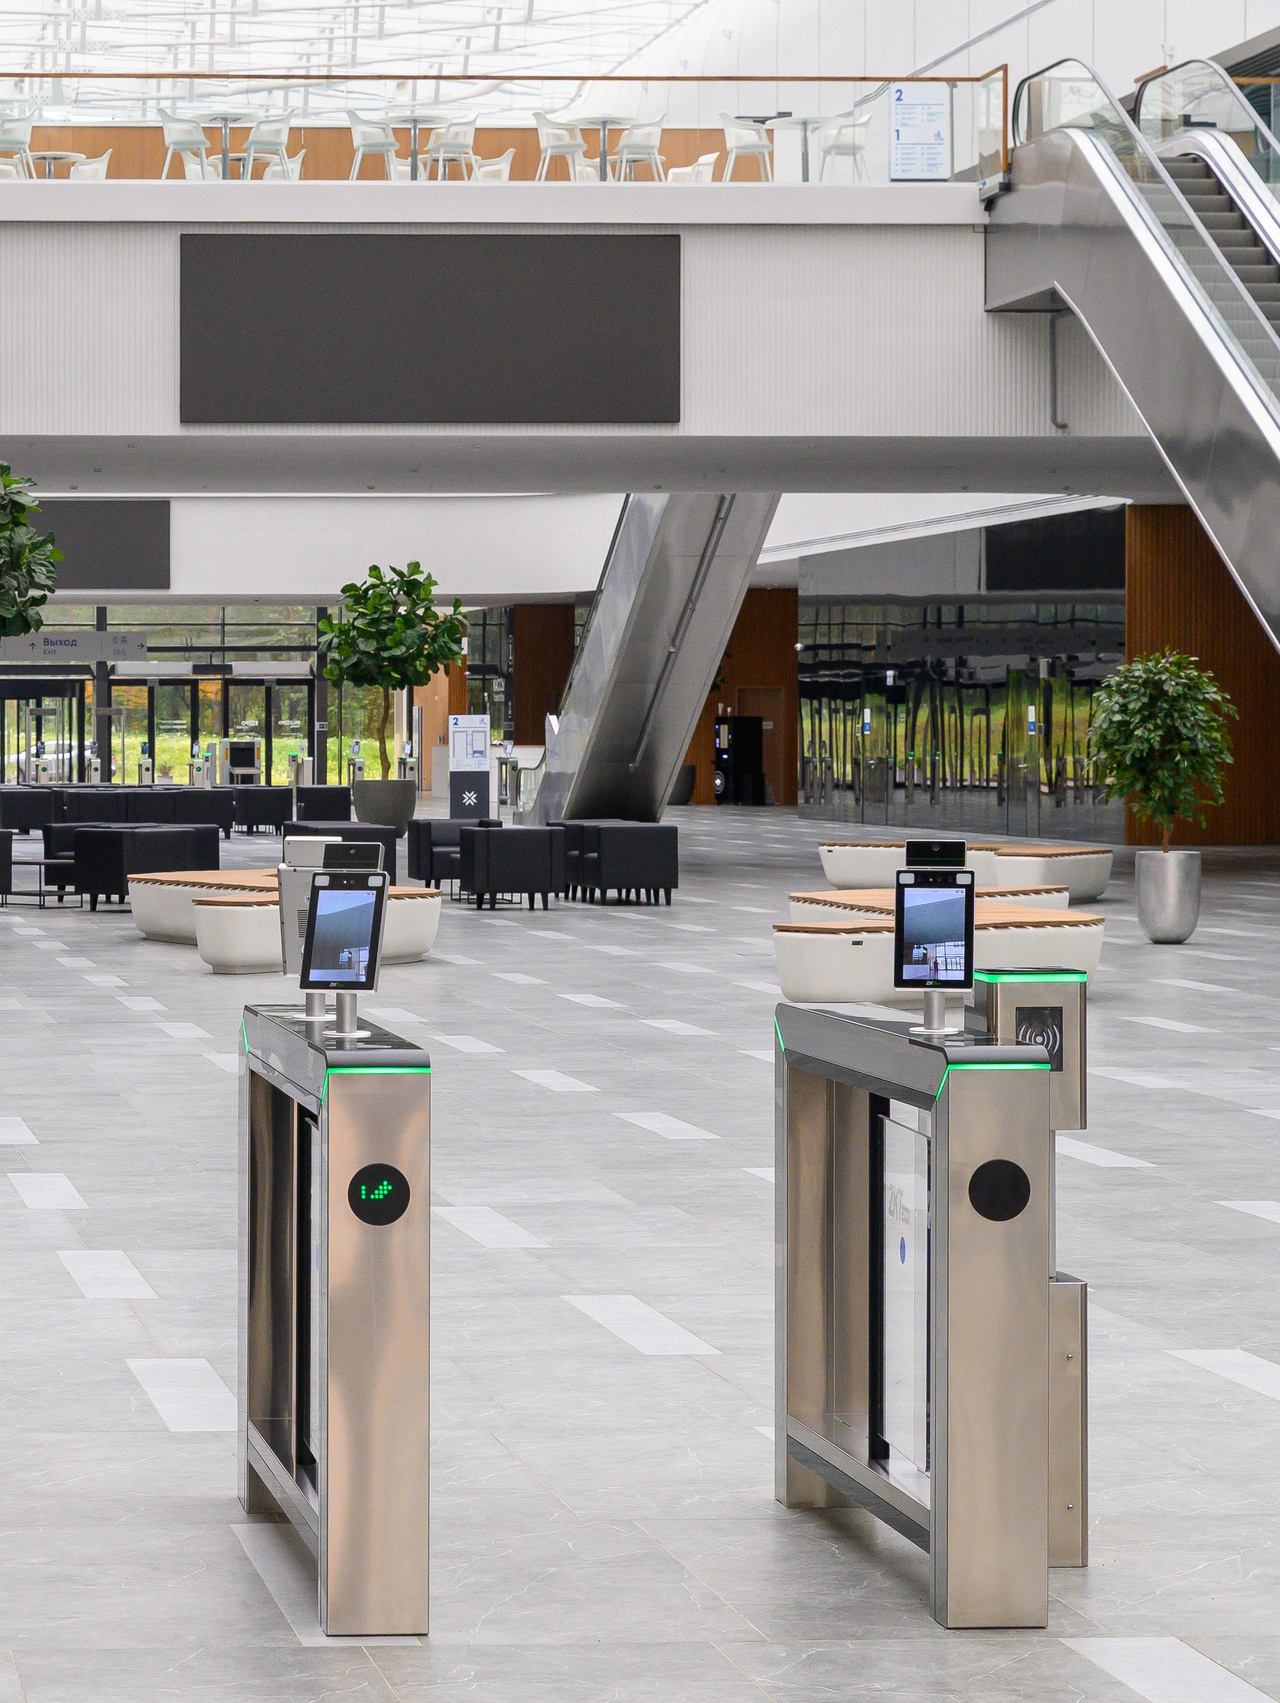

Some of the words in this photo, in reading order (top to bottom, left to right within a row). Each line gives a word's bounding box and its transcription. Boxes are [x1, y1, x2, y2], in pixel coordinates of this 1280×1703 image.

[895, 89, 903, 102] 2
[895, 129, 900, 141] 1
[43, 638, 78, 647] Выход
[452, 717, 459, 726] 2
